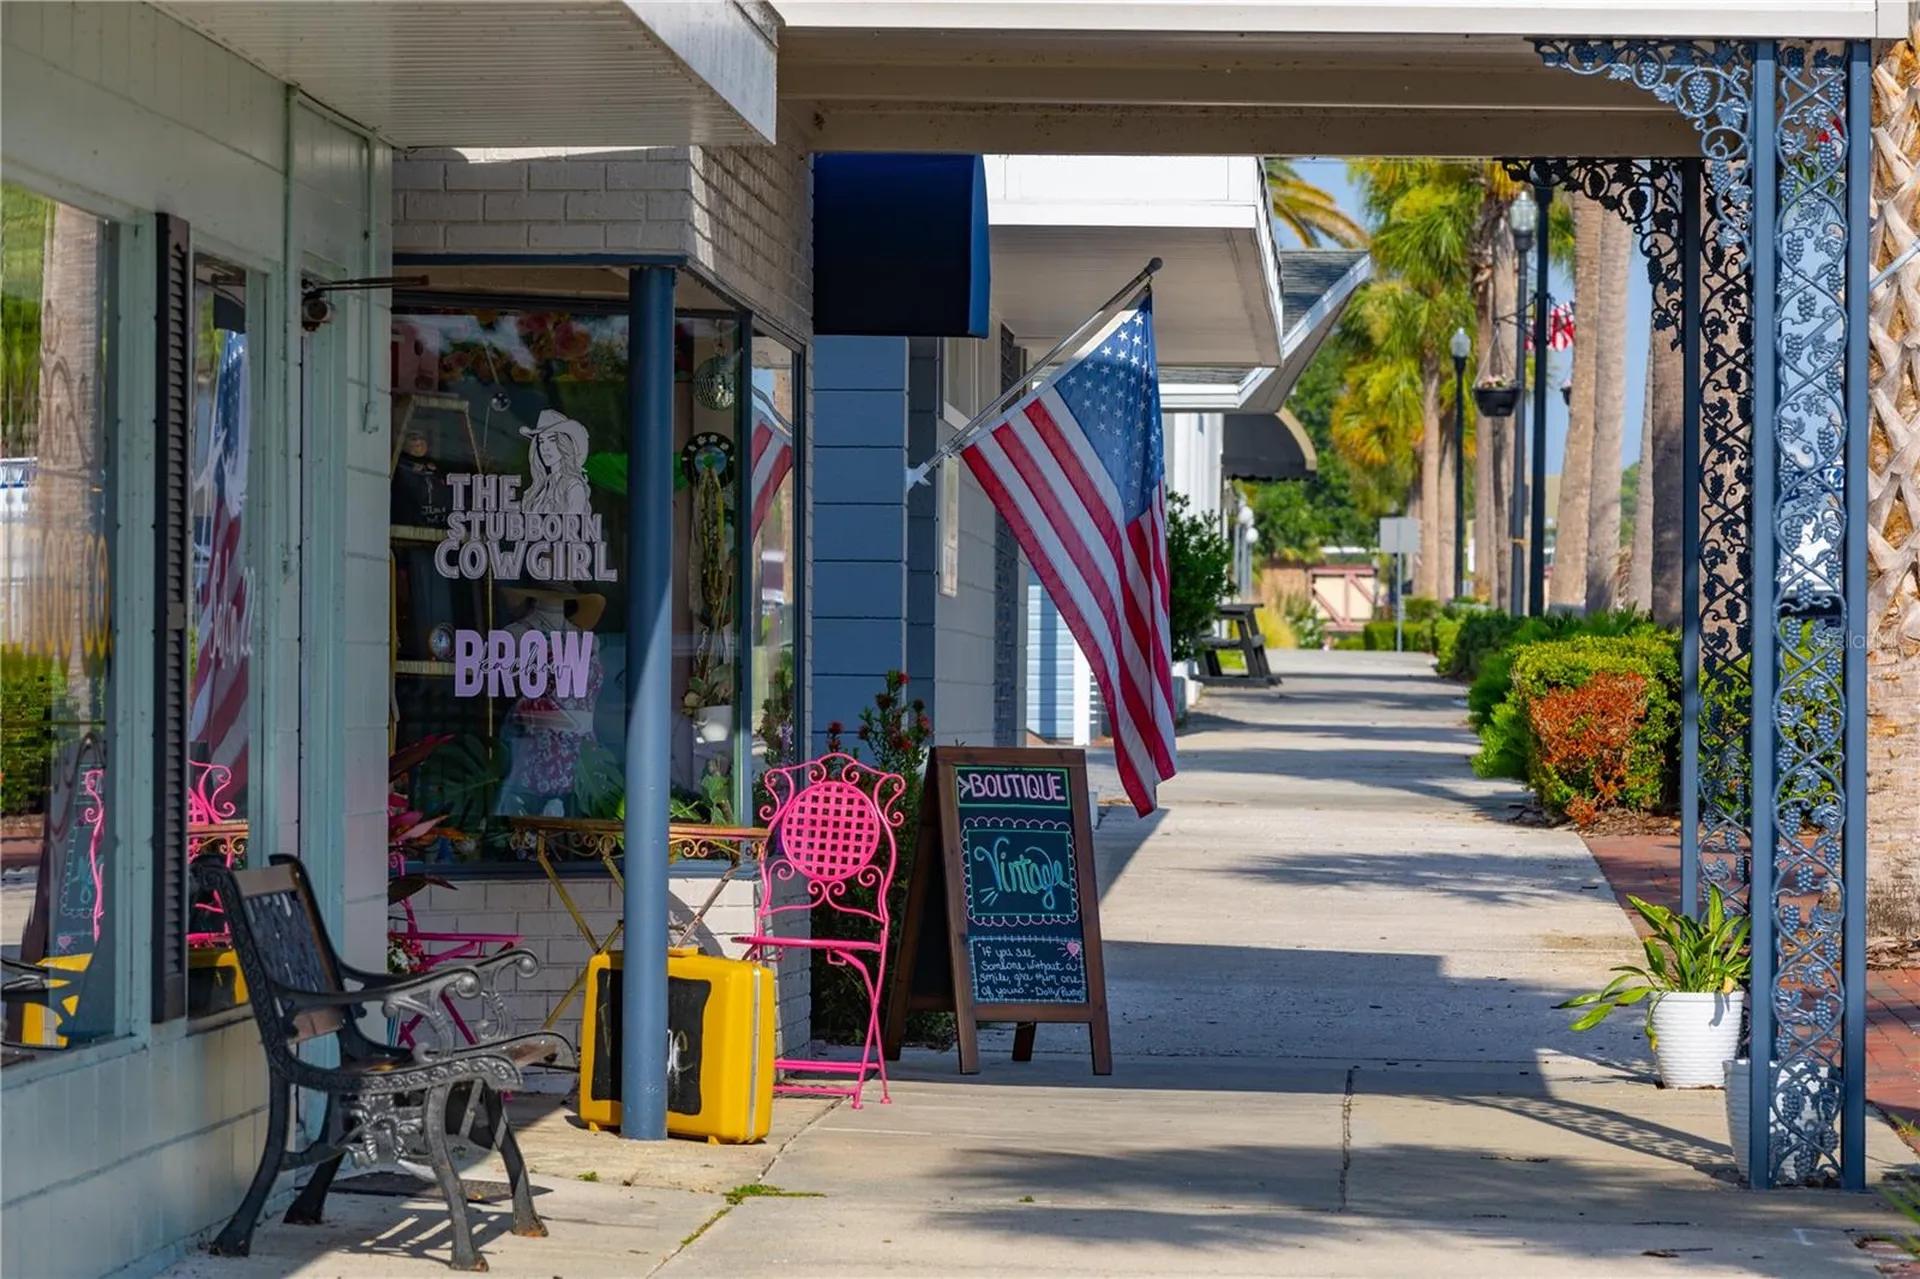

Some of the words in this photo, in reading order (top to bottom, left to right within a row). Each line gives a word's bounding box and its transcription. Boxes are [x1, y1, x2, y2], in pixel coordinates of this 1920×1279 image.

[446, 473, 522, 513] THE
[447, 511, 603, 543] STUBBORN
[434, 540, 618, 582] COWGIRL
[455, 629, 594, 698] BROW
[968, 772, 1066, 801] BOUTIQUE
[974, 836, 1070, 910] Vintage
[995, 948, 1013, 964] you
[1015, 947, 1036, 958] see
[1026, 959, 1064, 975] without
[1065, 963, 1078, 971] a
[1013, 972, 1034, 987] give
[1035, 970, 1060, 986] them
[1060, 975, 1082, 984] one
